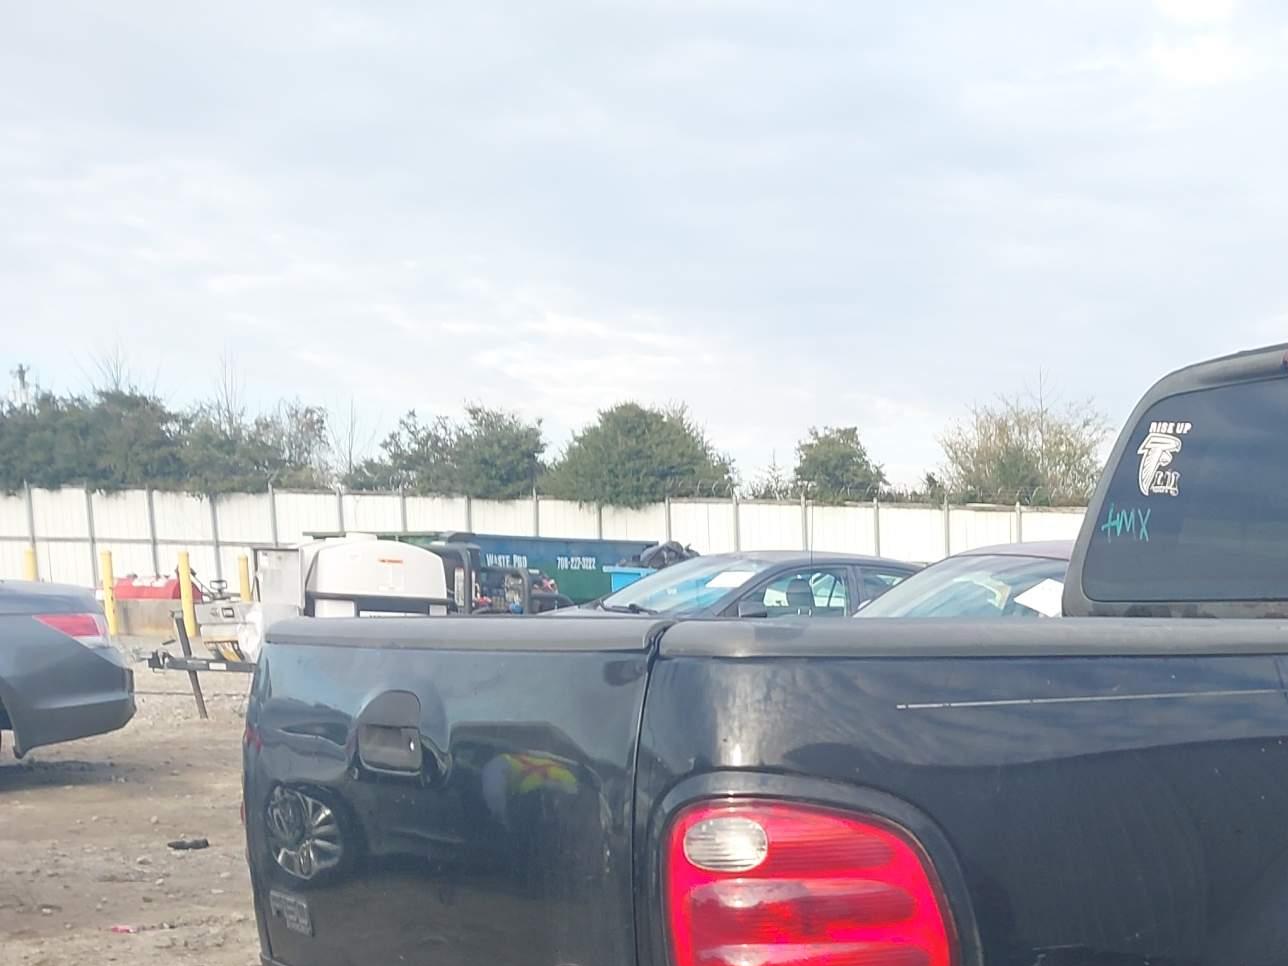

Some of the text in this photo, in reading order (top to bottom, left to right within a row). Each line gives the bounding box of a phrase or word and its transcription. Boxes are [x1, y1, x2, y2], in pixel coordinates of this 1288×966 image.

[1149, 421, 1192, 434] RISE UP
[513, 554, 527, 568] PRO
